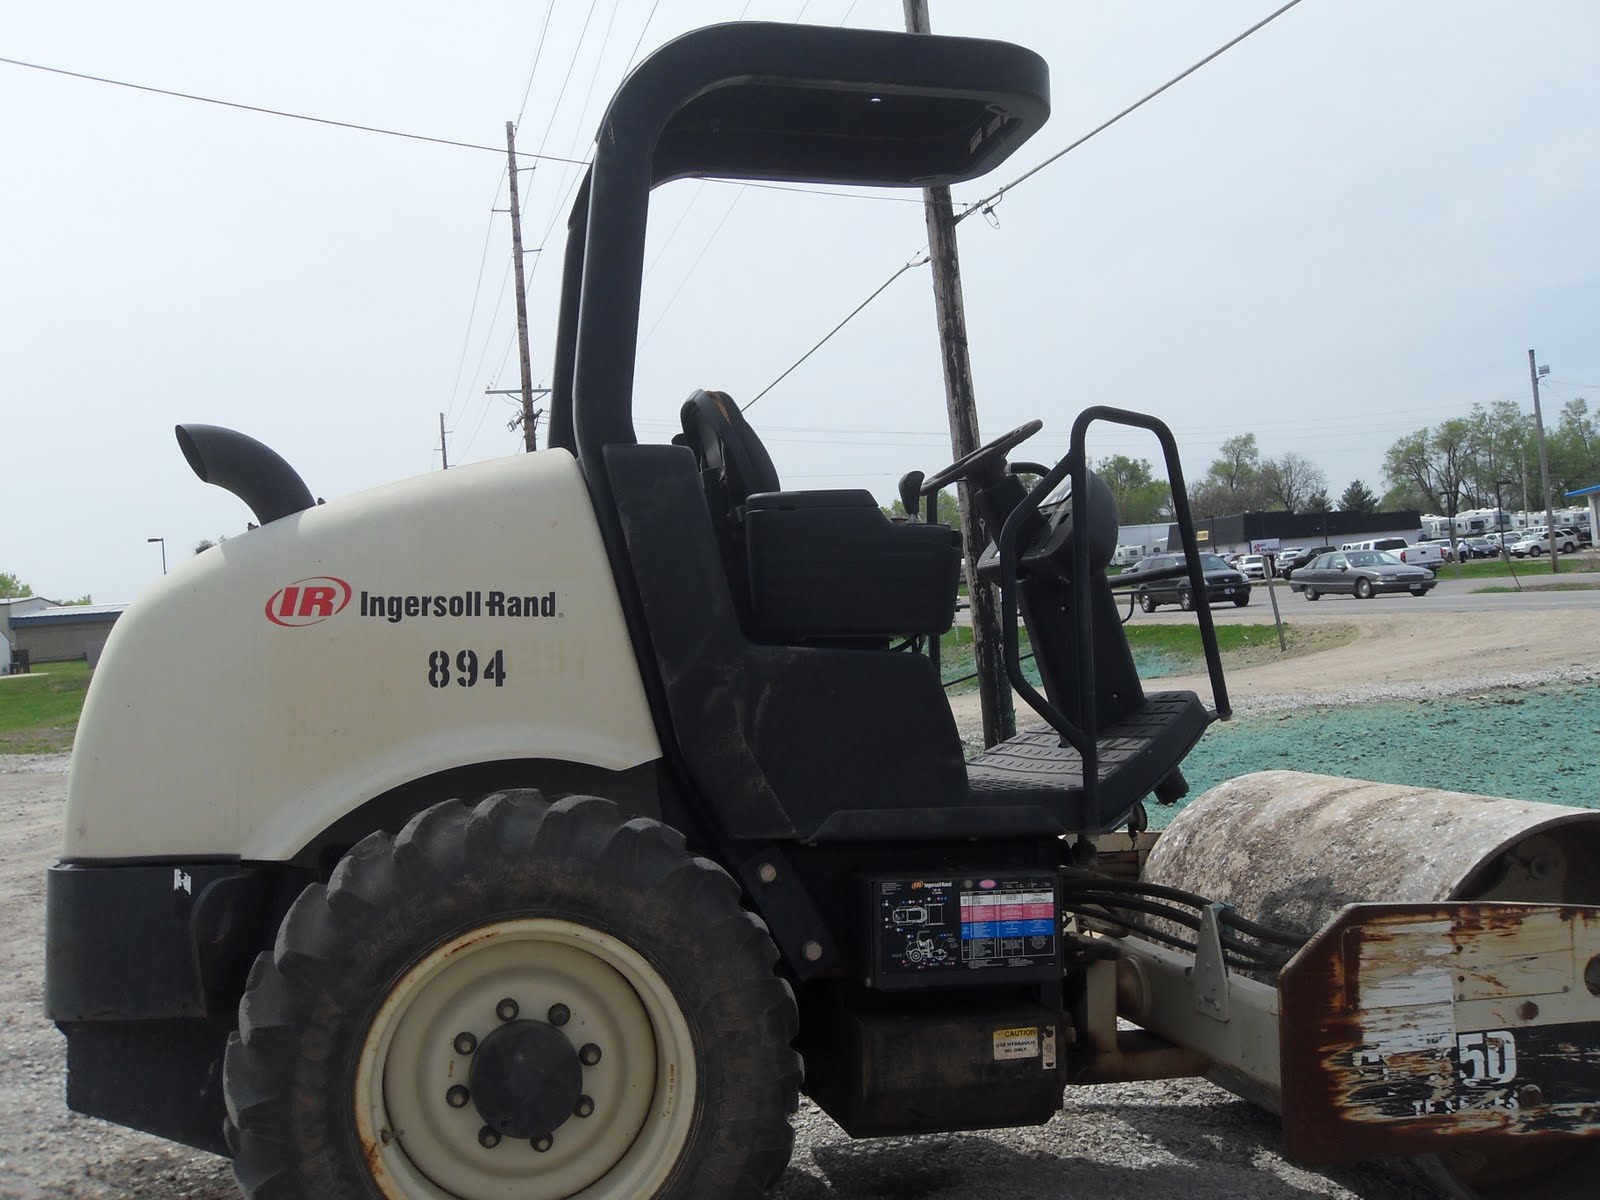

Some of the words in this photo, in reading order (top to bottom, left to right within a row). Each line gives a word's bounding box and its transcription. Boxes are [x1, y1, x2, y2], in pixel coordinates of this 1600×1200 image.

[278, 586, 337, 617] IR
[428, 649, 506, 688] 894
[1004, 1029, 1036, 1038] CAUTION
